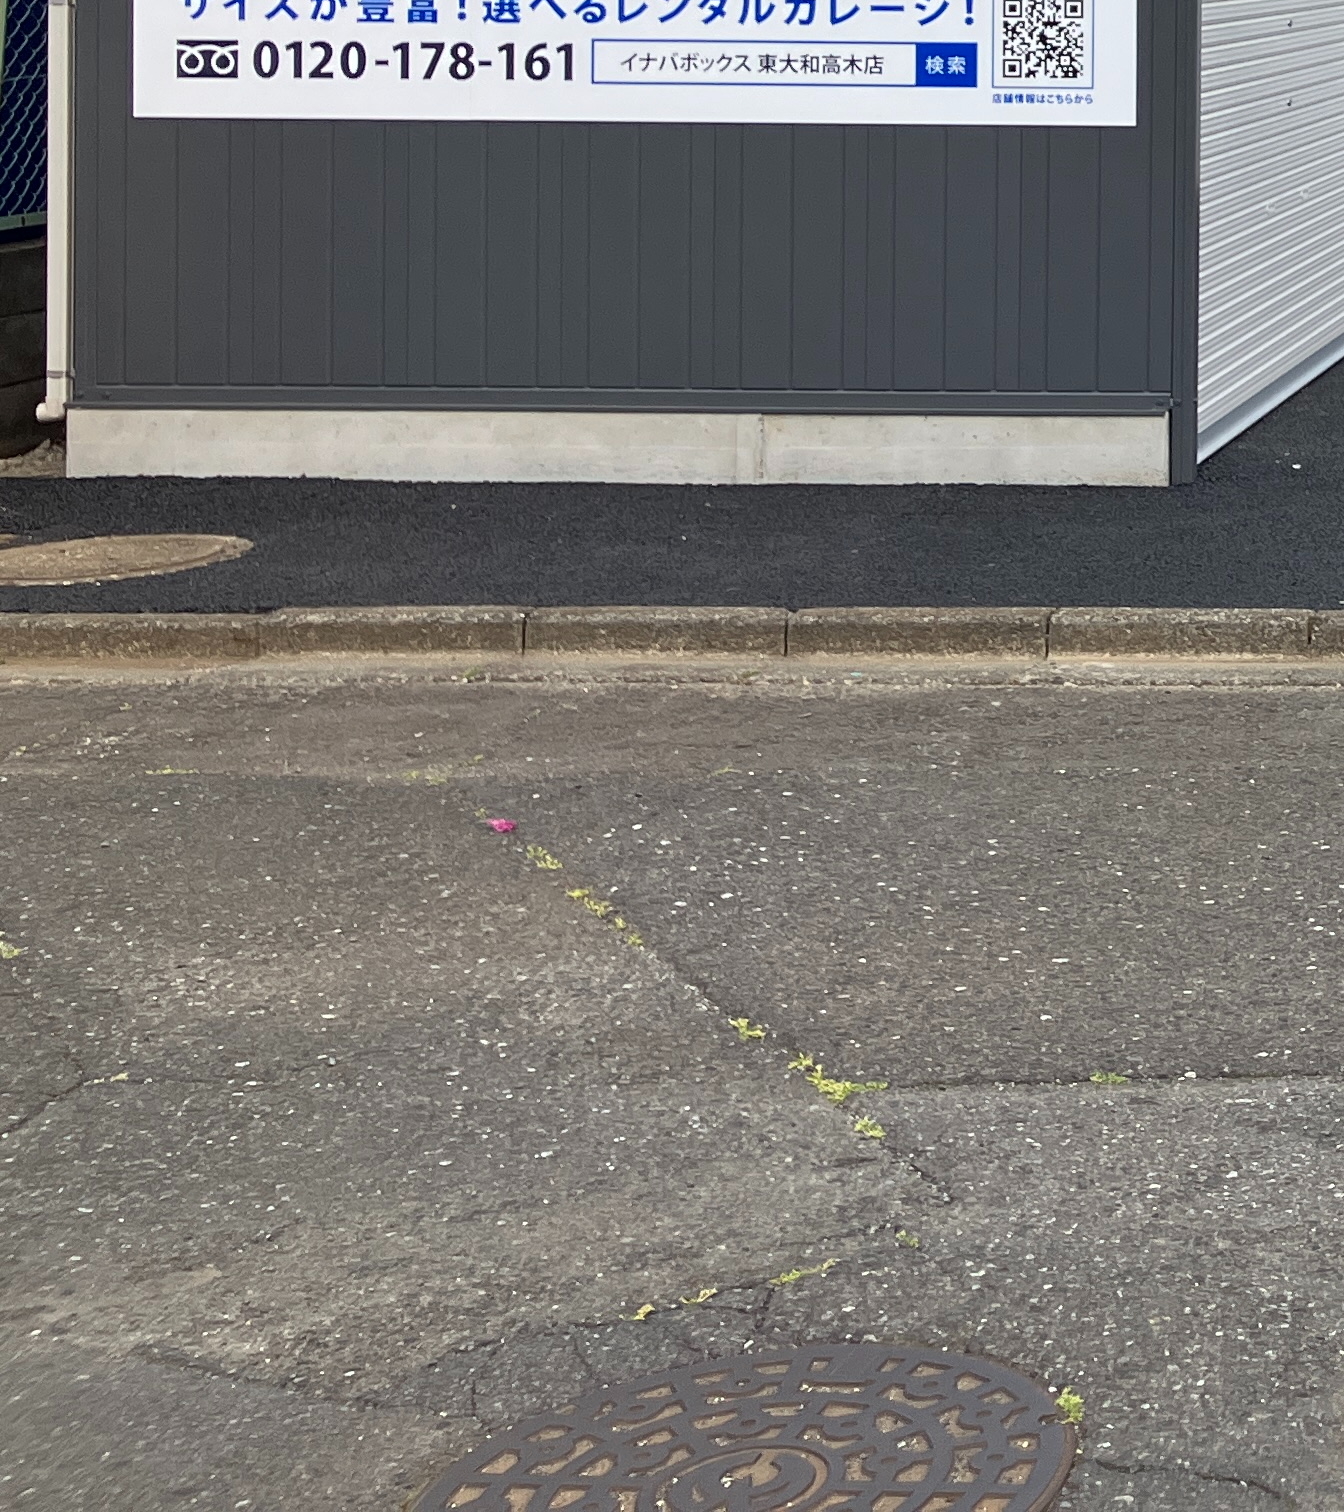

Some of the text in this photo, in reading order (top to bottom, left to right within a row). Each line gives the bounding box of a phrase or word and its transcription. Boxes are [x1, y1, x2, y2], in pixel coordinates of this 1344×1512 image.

[252, 39, 576, 82] 0120-178-161
[619, 52, 884, 76] イナバボックス 東大和高木店
[925, 55, 967, 76] 検索
[992, 93, 1093, 104] 店舗情報はこちらから
